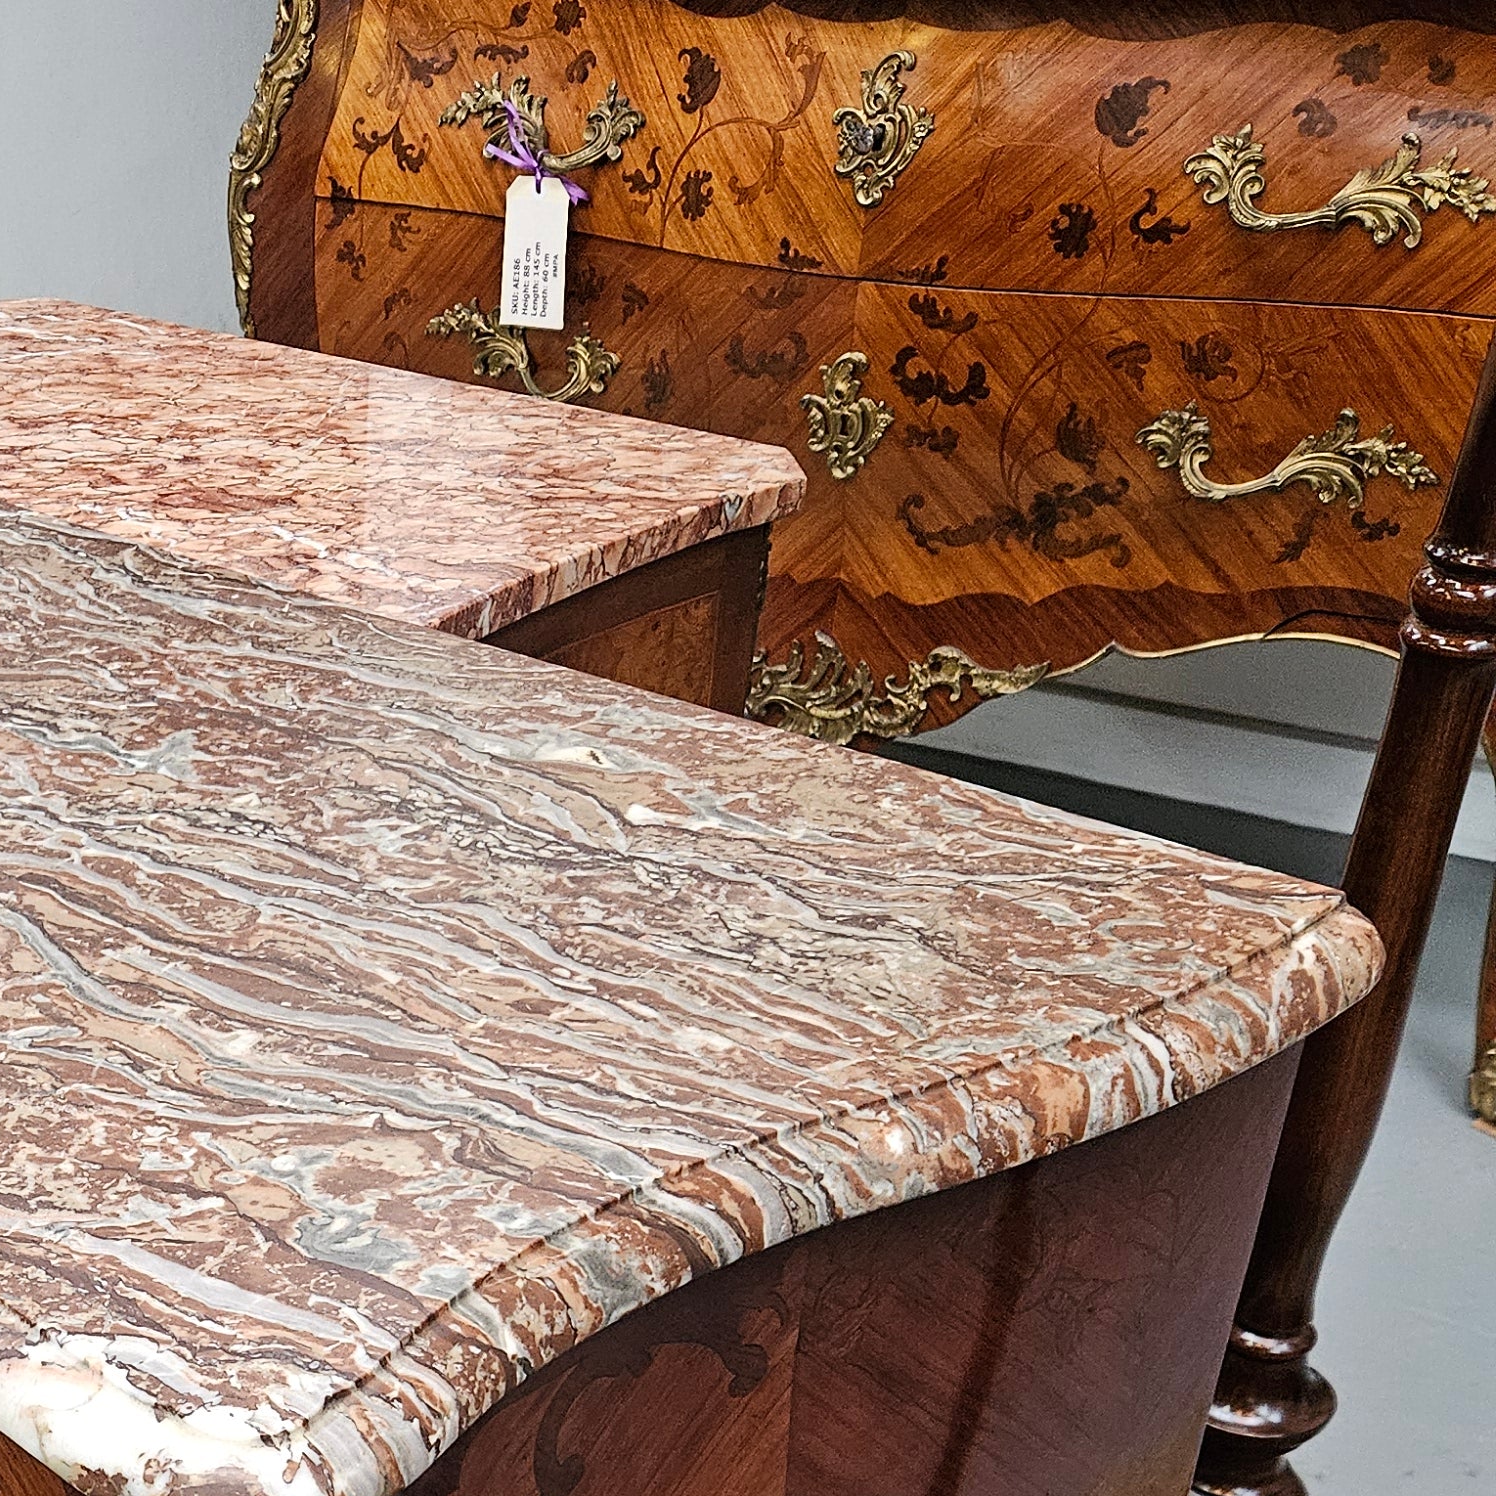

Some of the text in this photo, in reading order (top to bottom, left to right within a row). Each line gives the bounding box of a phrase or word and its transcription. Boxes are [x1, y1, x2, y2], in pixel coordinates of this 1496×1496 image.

[511, 292, 519, 314] SKU:
[522, 248, 531, 315] Height: 88 cm
[531, 280, 539, 316] Length:
[535, 242, 541, 256] cm
[540, 253, 549, 317] Depth: 60 cm
